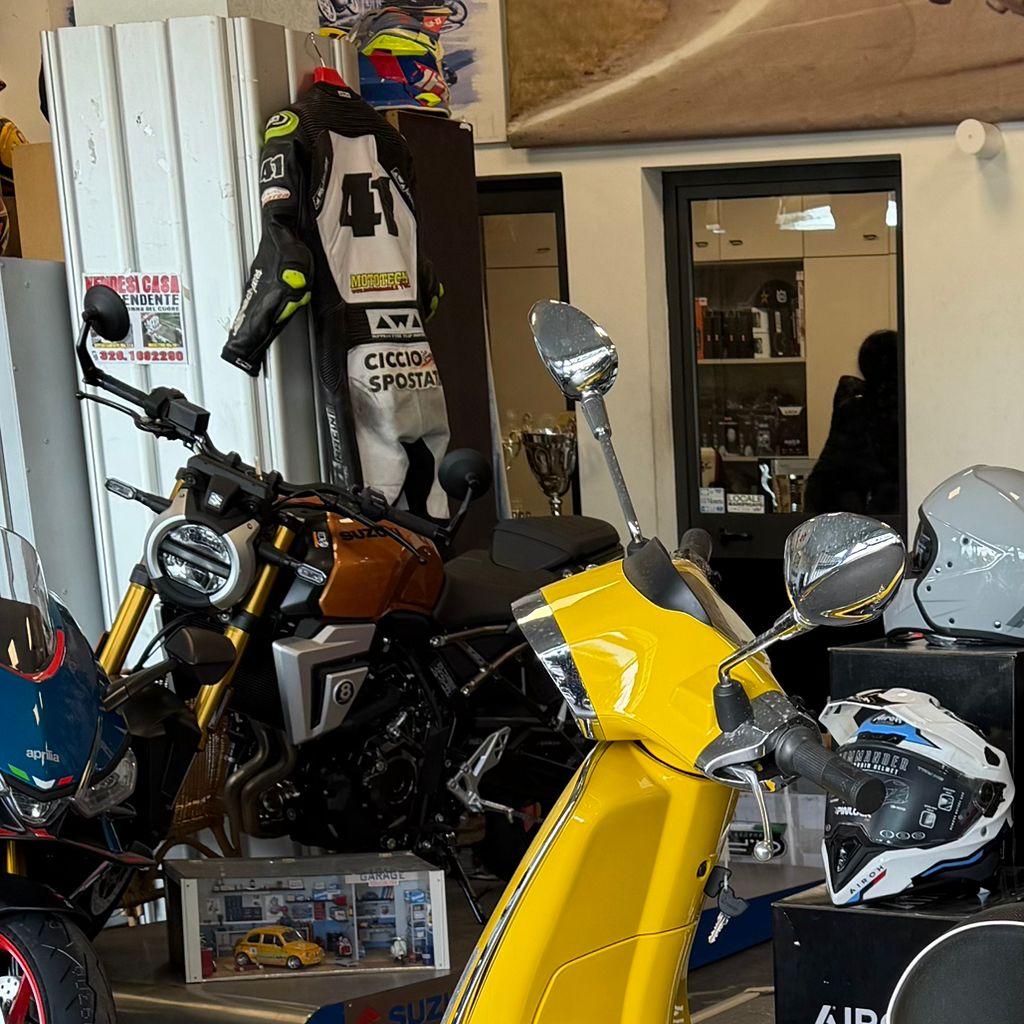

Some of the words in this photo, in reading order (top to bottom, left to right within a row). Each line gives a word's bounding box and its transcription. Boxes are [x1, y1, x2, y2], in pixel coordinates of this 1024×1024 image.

[260, 154, 284, 183] 41
[340, 173, 398, 237] 41
[142, 275, 180, 293] CASA
[121, 294, 180, 306] ENDENTE
[364, 351, 422, 370] CICCIO
[26, 747, 60, 766] aprilia
[360, 872, 405, 881] GARAGE
[849, 865, 885, 895] AIROH
